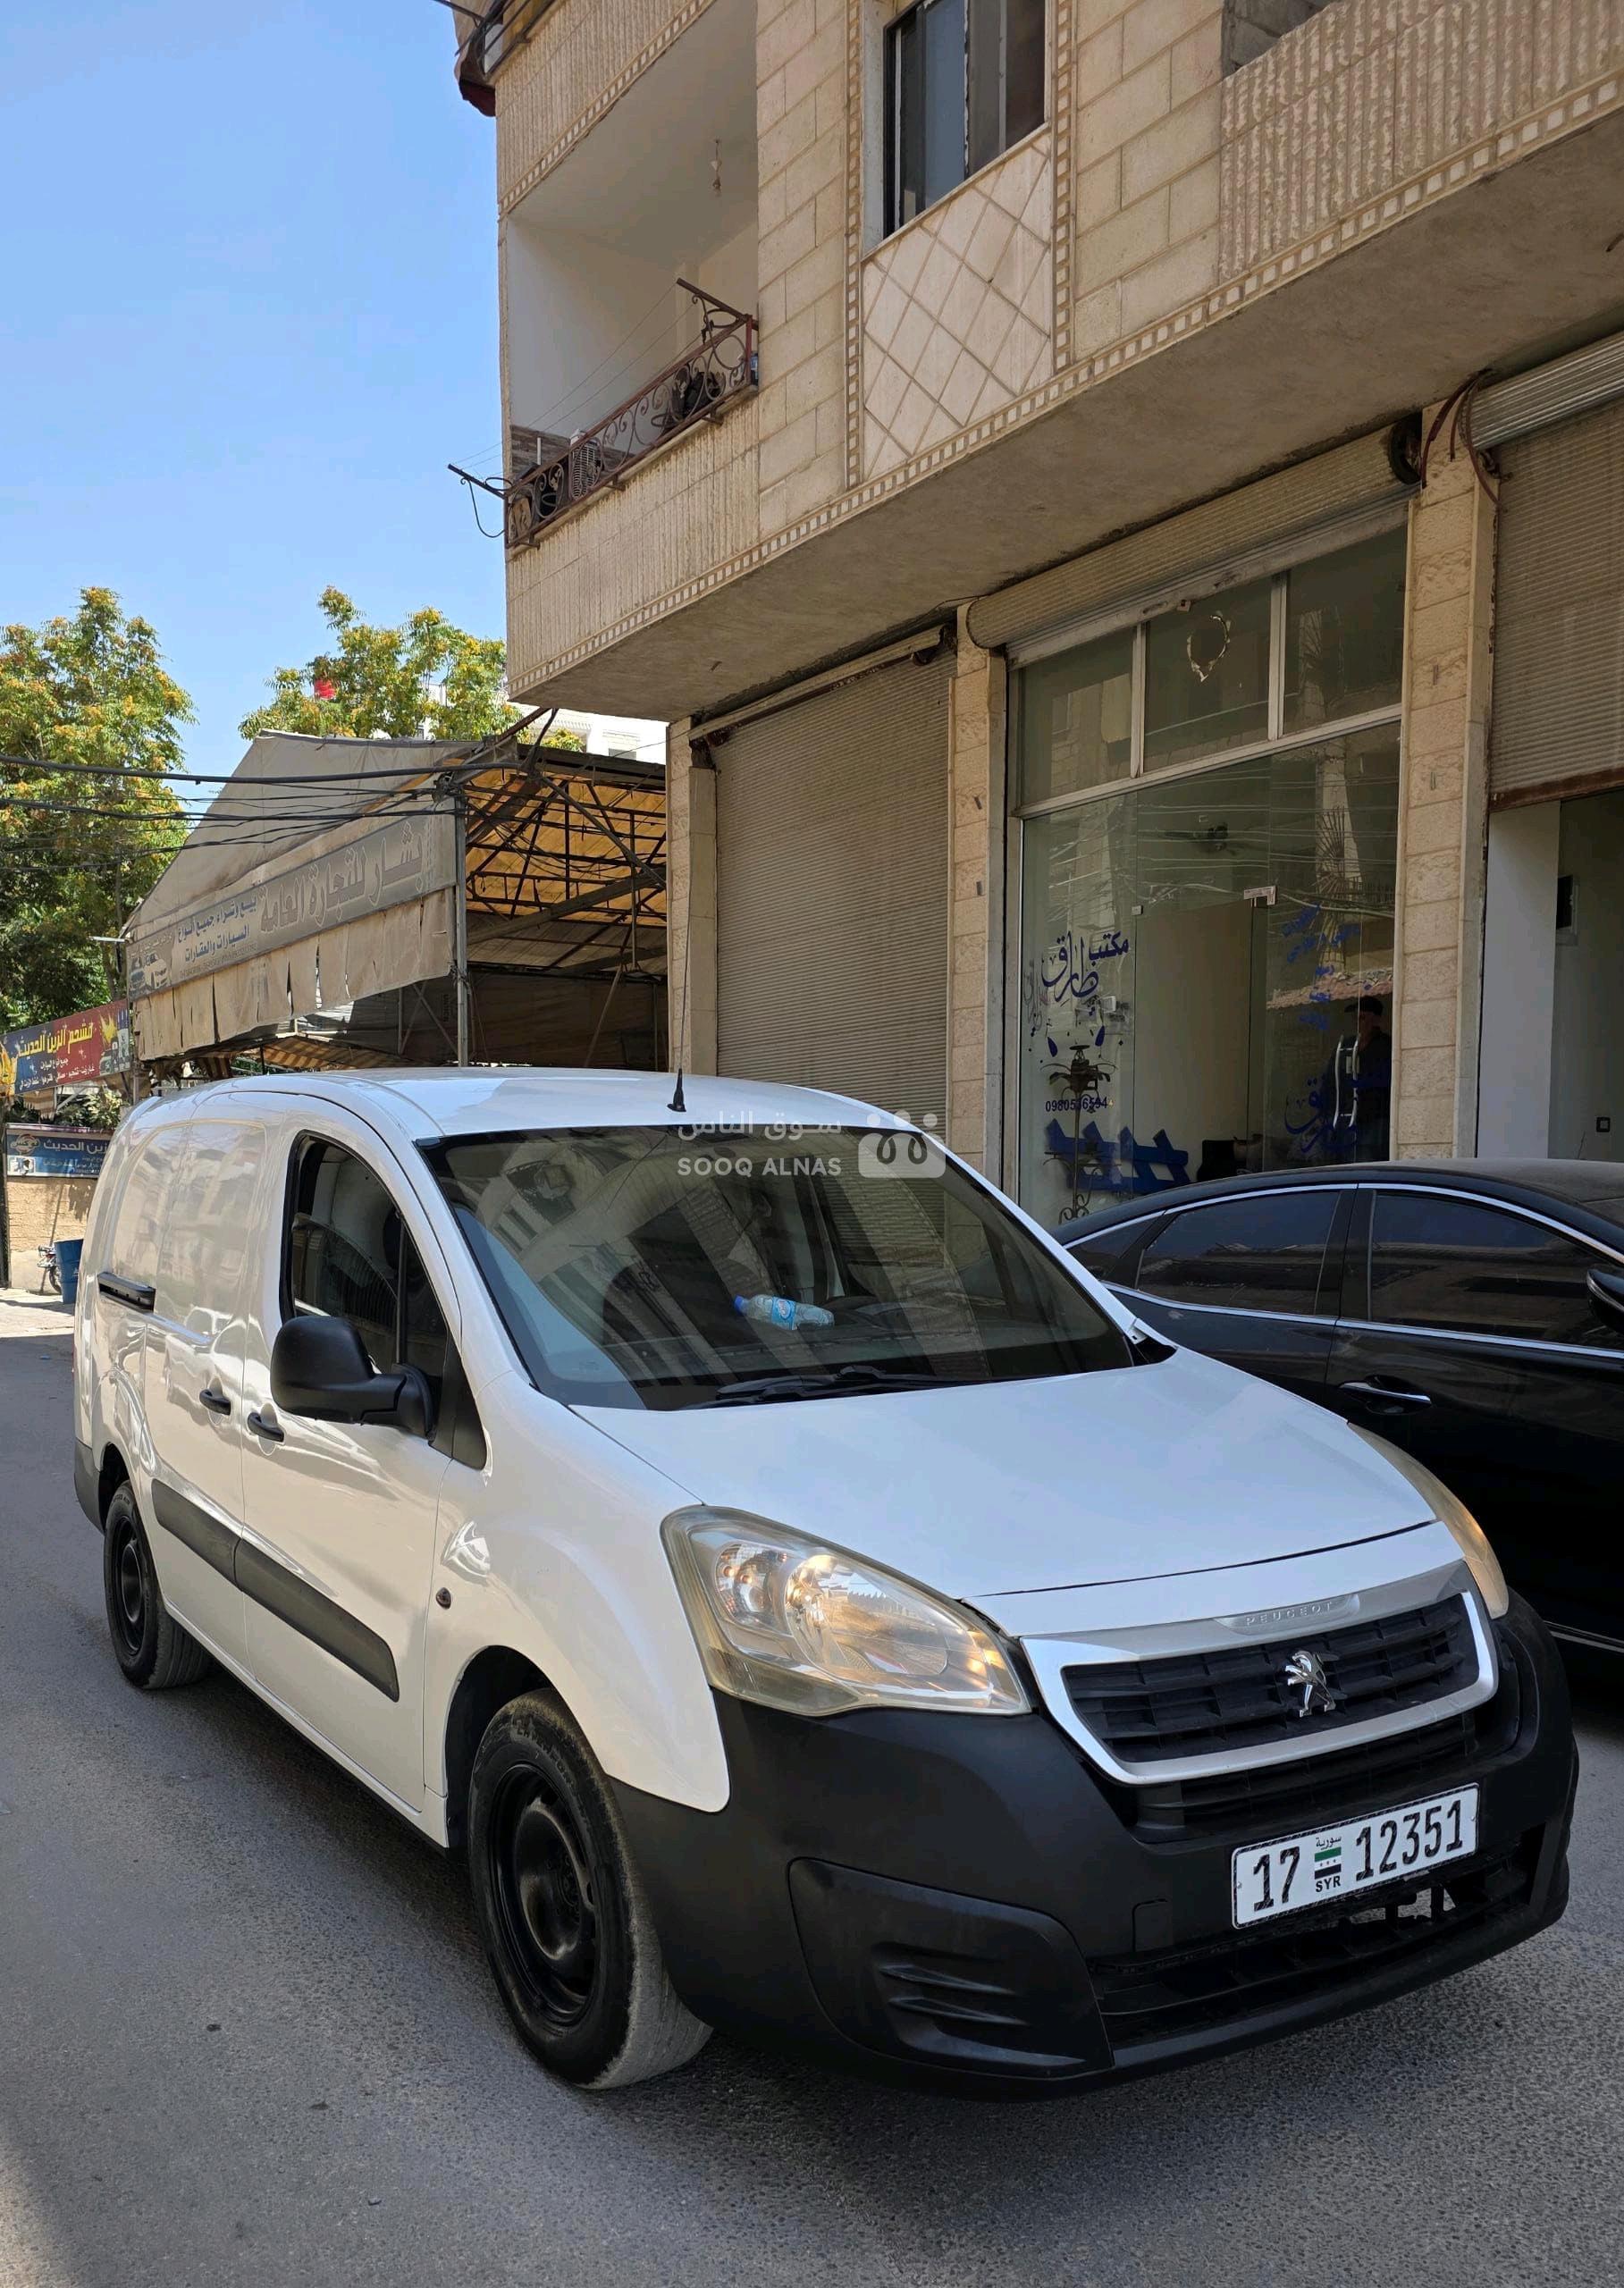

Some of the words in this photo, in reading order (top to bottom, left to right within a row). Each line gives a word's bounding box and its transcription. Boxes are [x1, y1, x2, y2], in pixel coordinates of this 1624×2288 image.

[368, 820, 424, 907] بشار
[308, 846, 367, 927] للتجارة
[257, 875, 306, 933] العامة
[184, 939, 216, 963] والعقارات
[216, 922, 250, 949] السيارات
[1089, 930, 1130, 967] مكتب
[1040, 930, 1100, 1003] طارق
[43, 1138, 85, 1152] الحديث
[1246, 1601, 1334, 1626] PEUGEOT
[1253, 1846, 1300, 1913] 17
[1355, 1799, 1464, 1881] 12351
[1315, 1835, 1342, 1850] سورية
[1315, 1874, 1342, 1893] SYR
